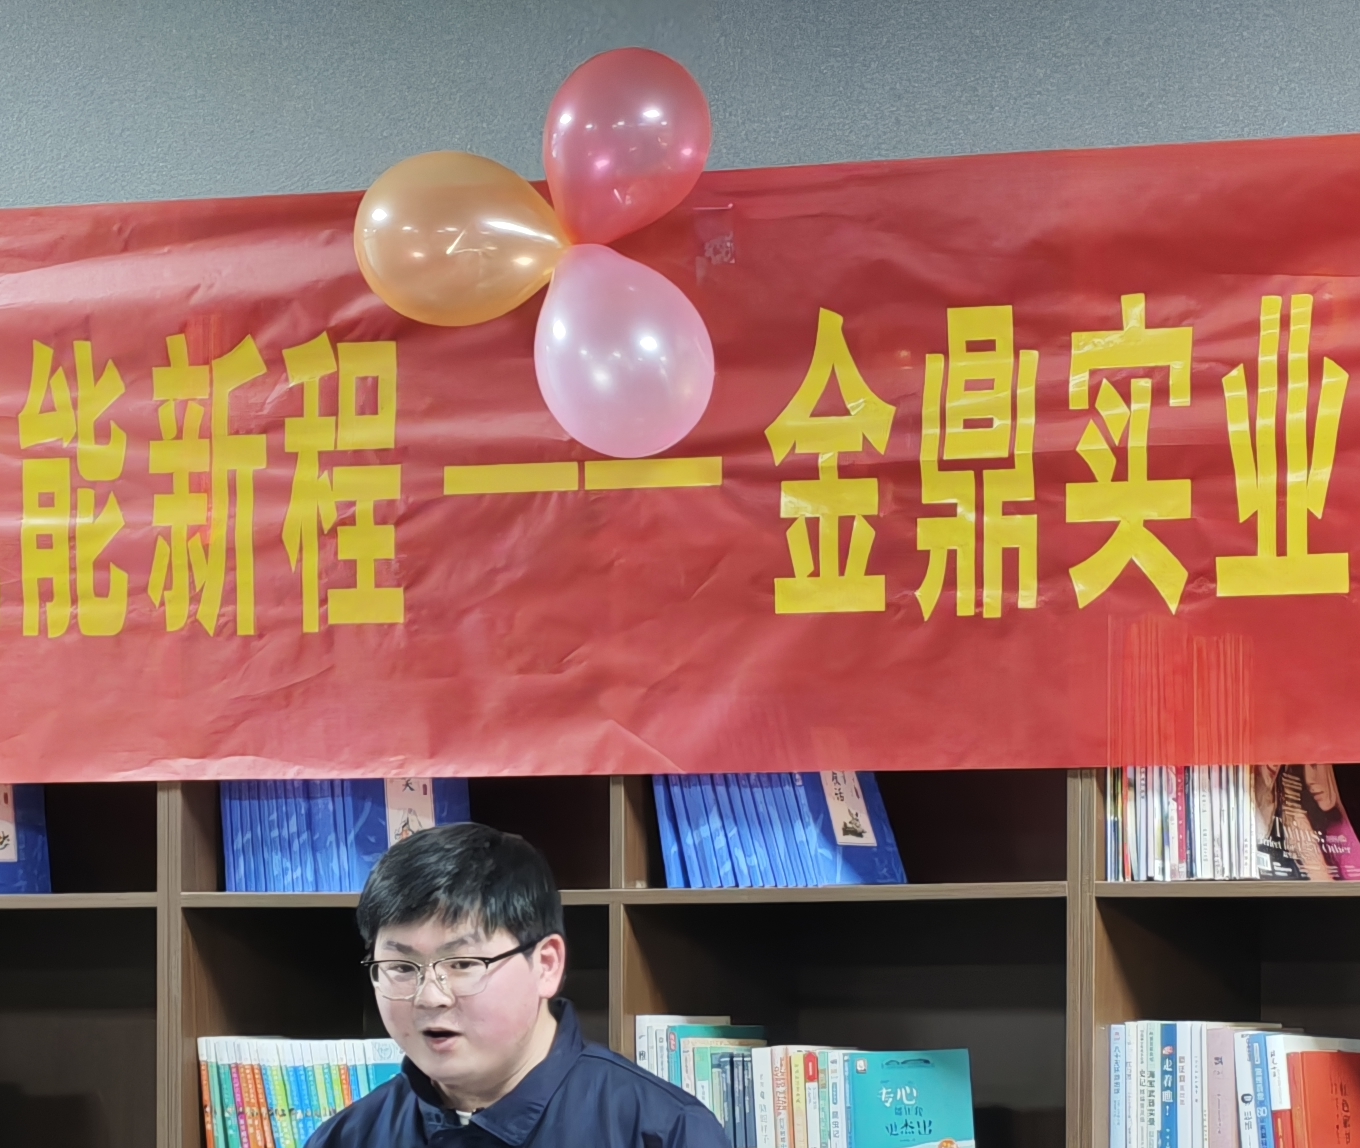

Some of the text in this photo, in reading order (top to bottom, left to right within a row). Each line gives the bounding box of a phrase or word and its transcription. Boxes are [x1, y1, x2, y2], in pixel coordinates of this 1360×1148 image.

[878, 1085, 918, 1108] 专心
[885, 1118, 934, 1138] 更杰出
